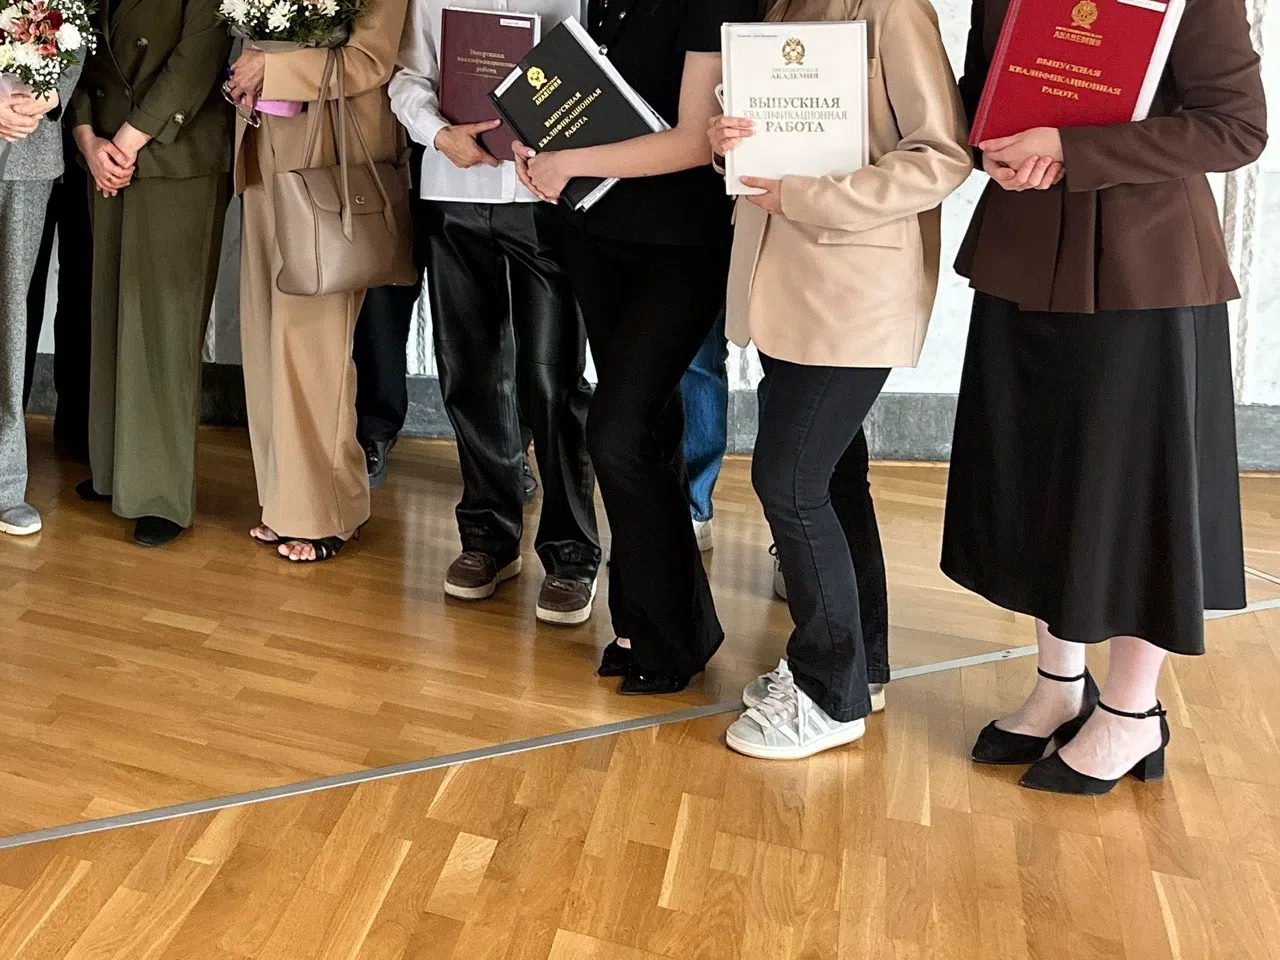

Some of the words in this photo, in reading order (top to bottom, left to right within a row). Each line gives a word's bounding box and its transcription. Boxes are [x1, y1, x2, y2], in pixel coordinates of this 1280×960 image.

[1036, 57, 1102, 77] ВЫПУСКНАЯ
[1008, 65, 1122, 95] КВАЛИФИКАЦИОННАЯ
[749, 97, 841, 108] ВЫПУСКНАЯ
[1041, 86, 1079, 100] РАБОТА
[538, 88, 602, 148] КВАЛИФИКАЦИОННАЯ
[544, 91, 582, 128] ВЫПУСКНАЯ
[564, 116, 589, 138] РАБОТА
[765, 121, 825, 132] РАБОТА
